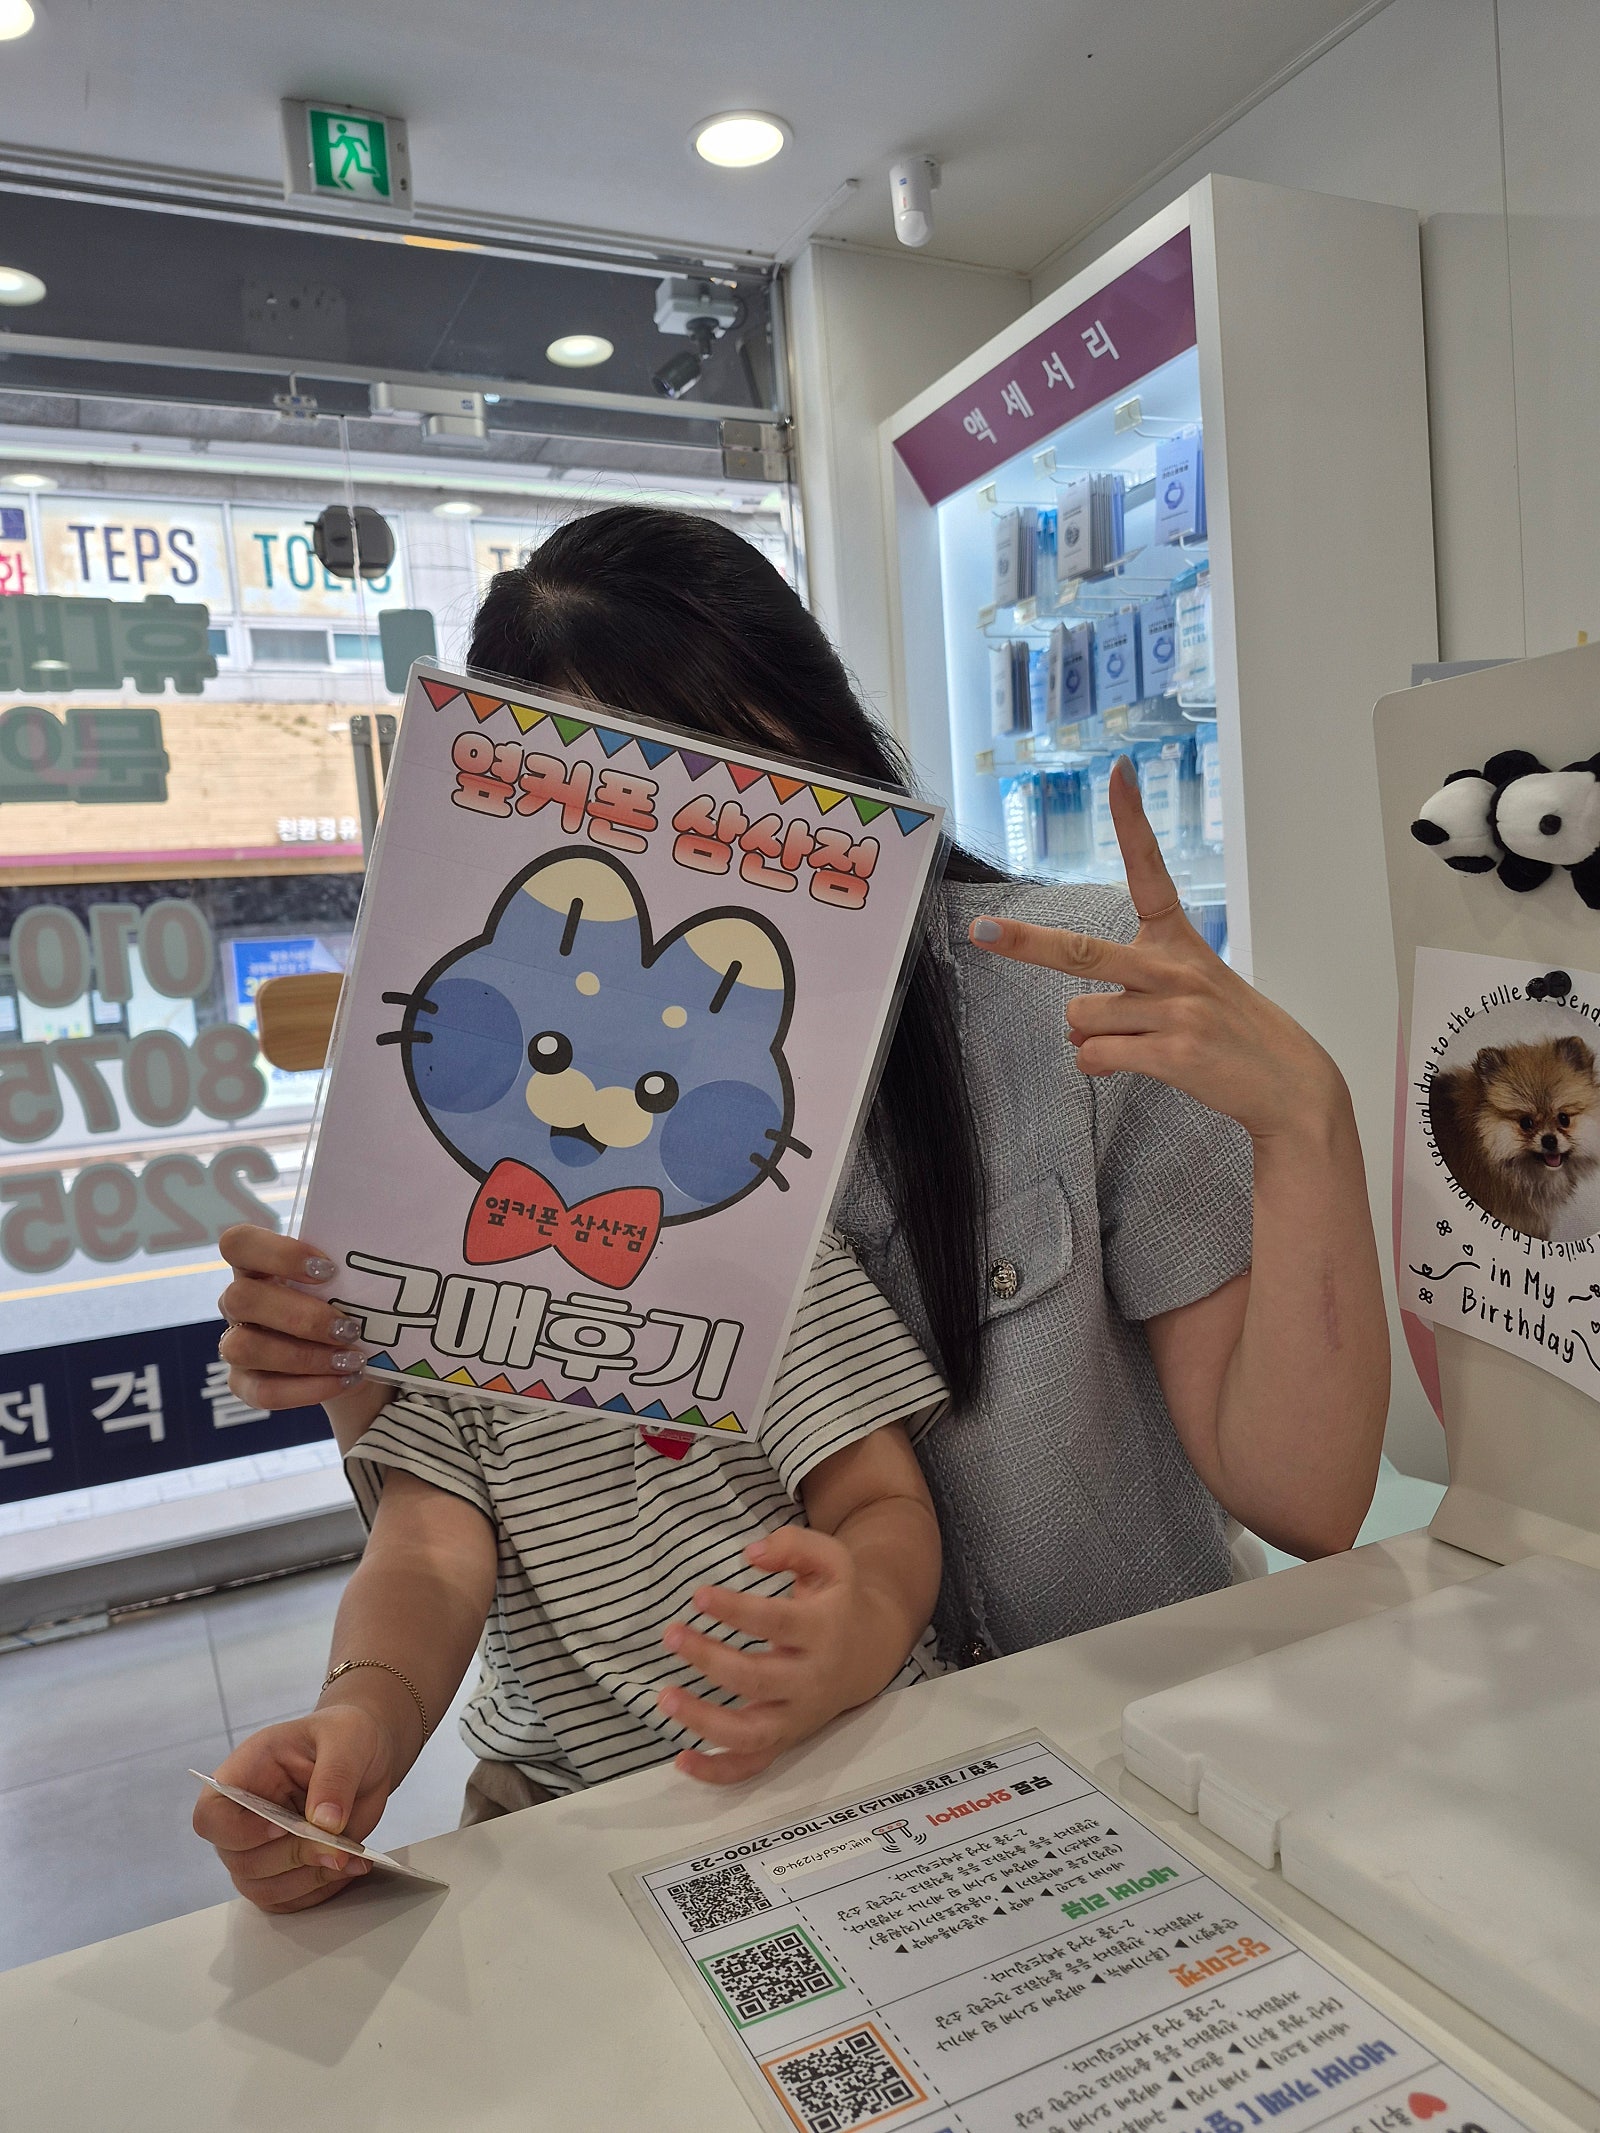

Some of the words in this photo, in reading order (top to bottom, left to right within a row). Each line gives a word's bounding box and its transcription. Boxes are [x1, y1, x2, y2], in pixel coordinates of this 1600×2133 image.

[963, 319, 1120, 444] 액세서리
[68, 525, 198, 585] TEPS
[452, 731, 659, 854] 옆커폰
[672, 794, 880, 910] 삼산점
[1447, 1006, 1475, 1034] the
[1431, 1036, 1449, 1056] to
[1414, 1060, 1439, 1094] day
[1416, 1102, 1446, 1167] special
[1444, 1175, 1476, 1211] your
[485, 1196, 559, 1237] 옆커폰
[570, 1211, 648, 1254] 삼산점
[1480, 1210, 1532, 1255] Enjoy
[1490, 1258, 1511, 1288] in
[1524, 1267, 1555, 1308] My
[329, 1250, 744, 1401] 구매후기
[1461, 1286, 1575, 1364] Birthday
[967, 1757, 1000, 1777] 농협
[1008, 1775, 1054, 1796] 무료
[925, 1788, 1013, 1827] 와이파이
[690, 1807, 859, 1873] 351-1100-2700-23
[992, 1828, 1028, 1846] 2-3줄
[1052, 1818, 1100, 1840] 친절하다
[964, 1842, 993, 1857] 작성
[980, 1845, 1027, 1866] 솔직하고
[1028, 1836, 1053, 1850] 등등
[1057, 1835, 1102, 1856] 리뷰쓰기
[887, 1852, 964, 1882] 부탁드립니다.
[956, 1862, 982, 1877] 등등
[999, 1859, 1040, 1878] 매장에
[1014, 1867, 1064, 1890] 예약하기
[1087, 1862, 1126, 1880] 네이버
[906, 1871, 954, 1894] 솔직하고
[946, 1887, 962, 1899] 된
[962, 1872, 998, 1892] 오시게
[1054, 1874, 1088, 1894] 로그인
[1105, 1866, 1180, 1902] 네이버
[865, 1890, 908, 1911] 간단한
[906, 1894, 945, 1913] 계기나
[1008, 1896, 1035, 1912] 예약
[1060, 1893, 1110, 1920] 리뷰
[837, 1906, 861, 1922] 소감
[842, 1909, 904, 1934] 저렴하다,
[1144, 1911, 1204, 1937] 저렴하다,
[911, 1914, 989, 1950] 방문개통예약
[1095, 1918, 1135, 1940] 2-3줄
[1188, 1918, 1239, 1945] 단골맺기
[1066, 1935, 1097, 1953] 작성
[1092, 1936, 1146, 1963] 친절하다
[983, 1947, 1067, 1983] 부탁드립니다.
[1064, 1958, 1093, 1975] 등등
[1168, 1936, 1271, 1988] 당근마켓
[1010, 1969, 1063, 1996] 솔직하고
[966, 1991, 1012, 2016] 간단한
[1041, 1984, 1086, 2008] 매장에
[1236, 1991, 1301, 2021] 저렴하다,
[935, 2010, 962, 2030] 소감
[998, 2001, 1039, 2025] 오시게
[1183, 1998, 1226, 2024] 2-3줄
[980, 2020, 999, 2034] 된
[1151, 2017, 1185, 2038] 작성
[1182, 2019, 1239, 2050] 친절하다
[936, 2028, 980, 2052] 계기나
[1063, 2031, 1153, 2074] 부탁드립니다.
[1152, 2044, 1183, 2065] 등등
[1311, 2039, 1397, 2089] 네이버
[1095, 2057, 1151, 2090] 솔직하고
[1047, 2084, 1097, 2113] 간단한
[1254, 2079, 1321, 2117] 카페
[1014, 2106, 1043, 2126] 소감
